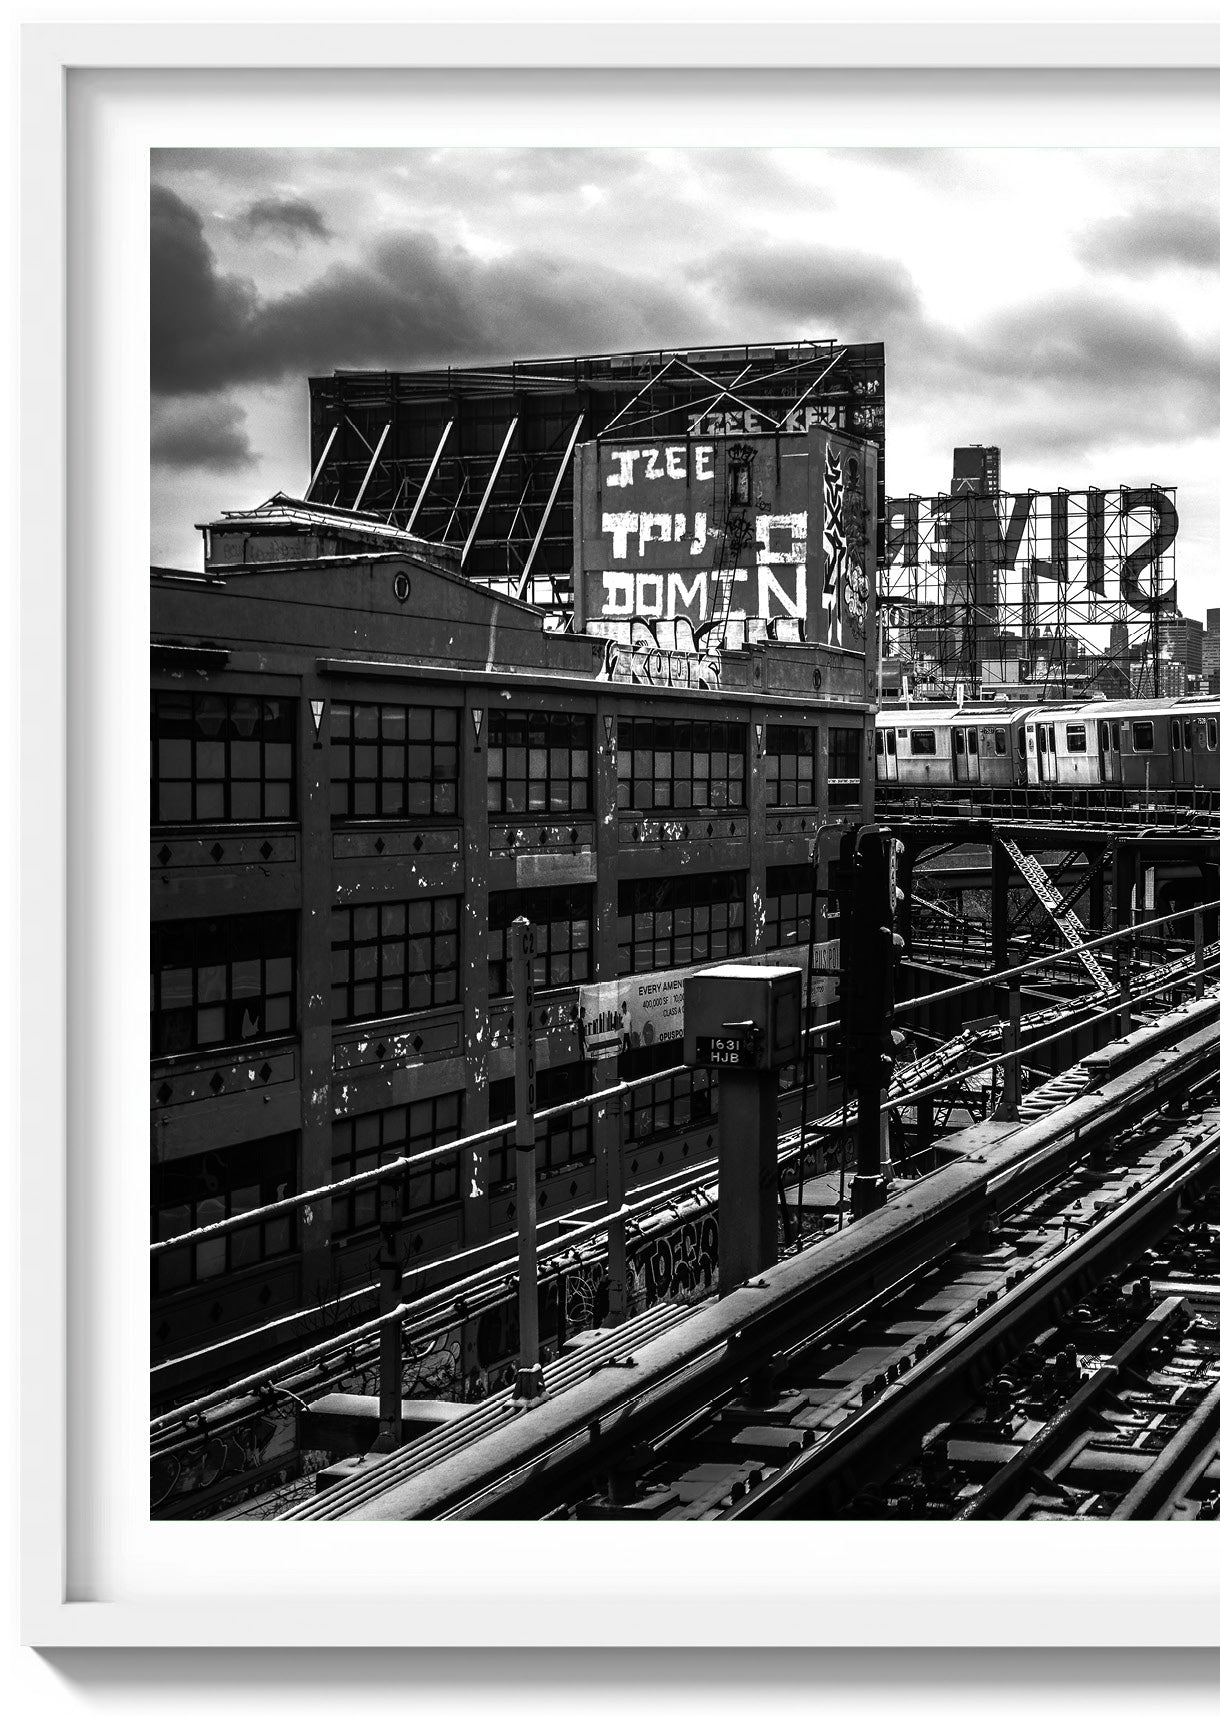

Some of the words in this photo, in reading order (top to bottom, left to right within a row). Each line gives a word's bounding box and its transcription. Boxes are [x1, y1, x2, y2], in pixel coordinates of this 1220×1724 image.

[522, 933, 534, 955] C2
[638, 983, 662, 996] EVERY
[711, 1039, 740, 1050] 1631
[711, 1051, 740, 1063] HJB
